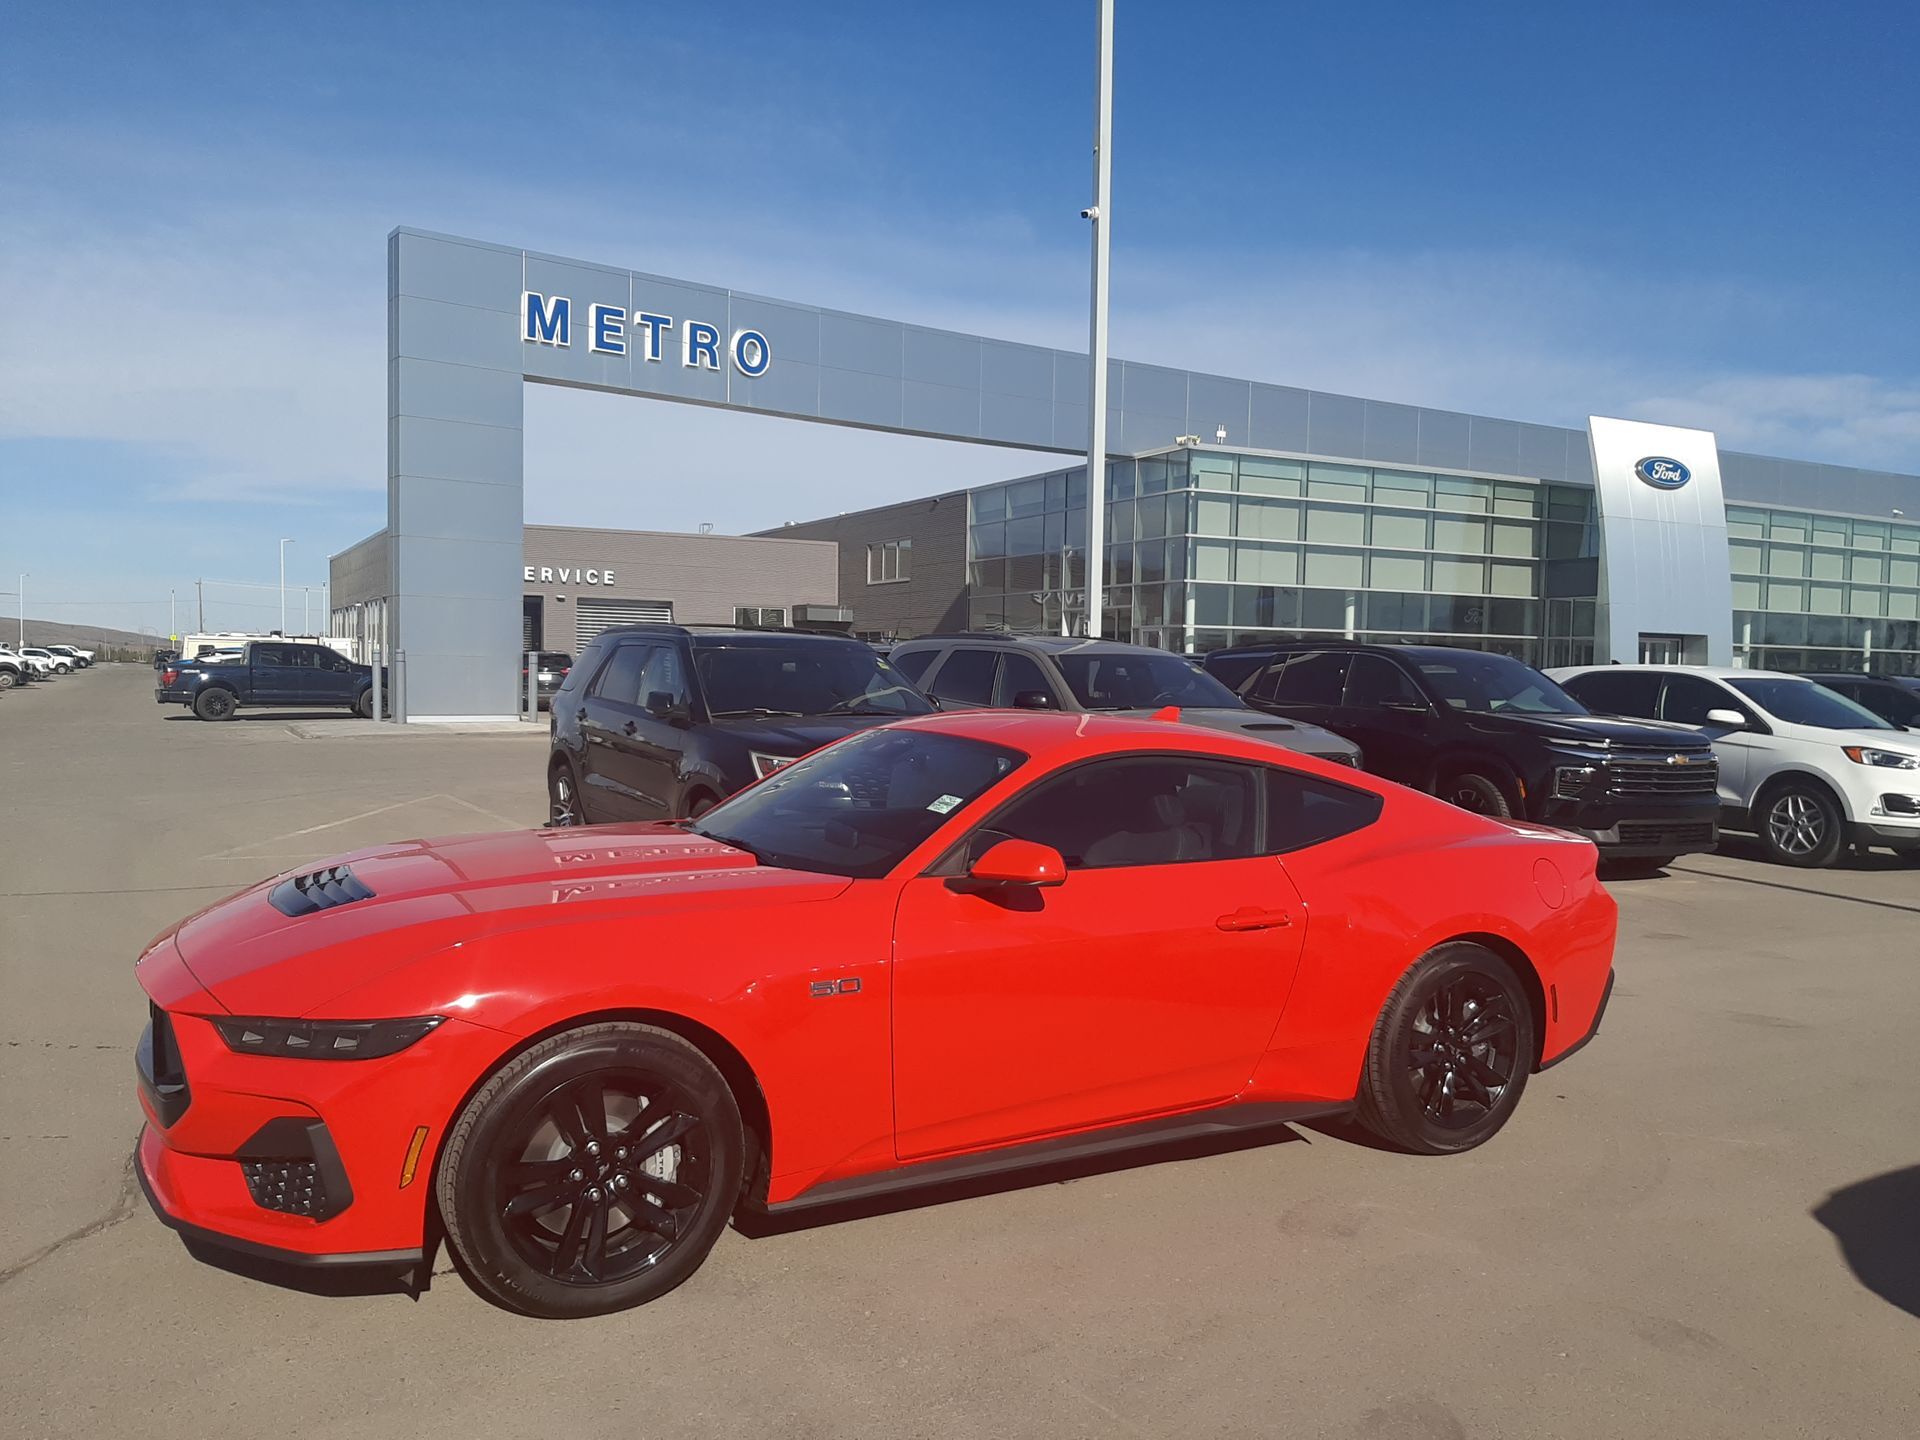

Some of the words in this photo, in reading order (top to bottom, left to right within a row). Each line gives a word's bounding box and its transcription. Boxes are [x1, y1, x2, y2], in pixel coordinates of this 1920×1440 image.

[521, 290, 771, 377] METRO
[1652, 461, 1681, 481] Ford
[524, 566, 615, 585] ERVICE
